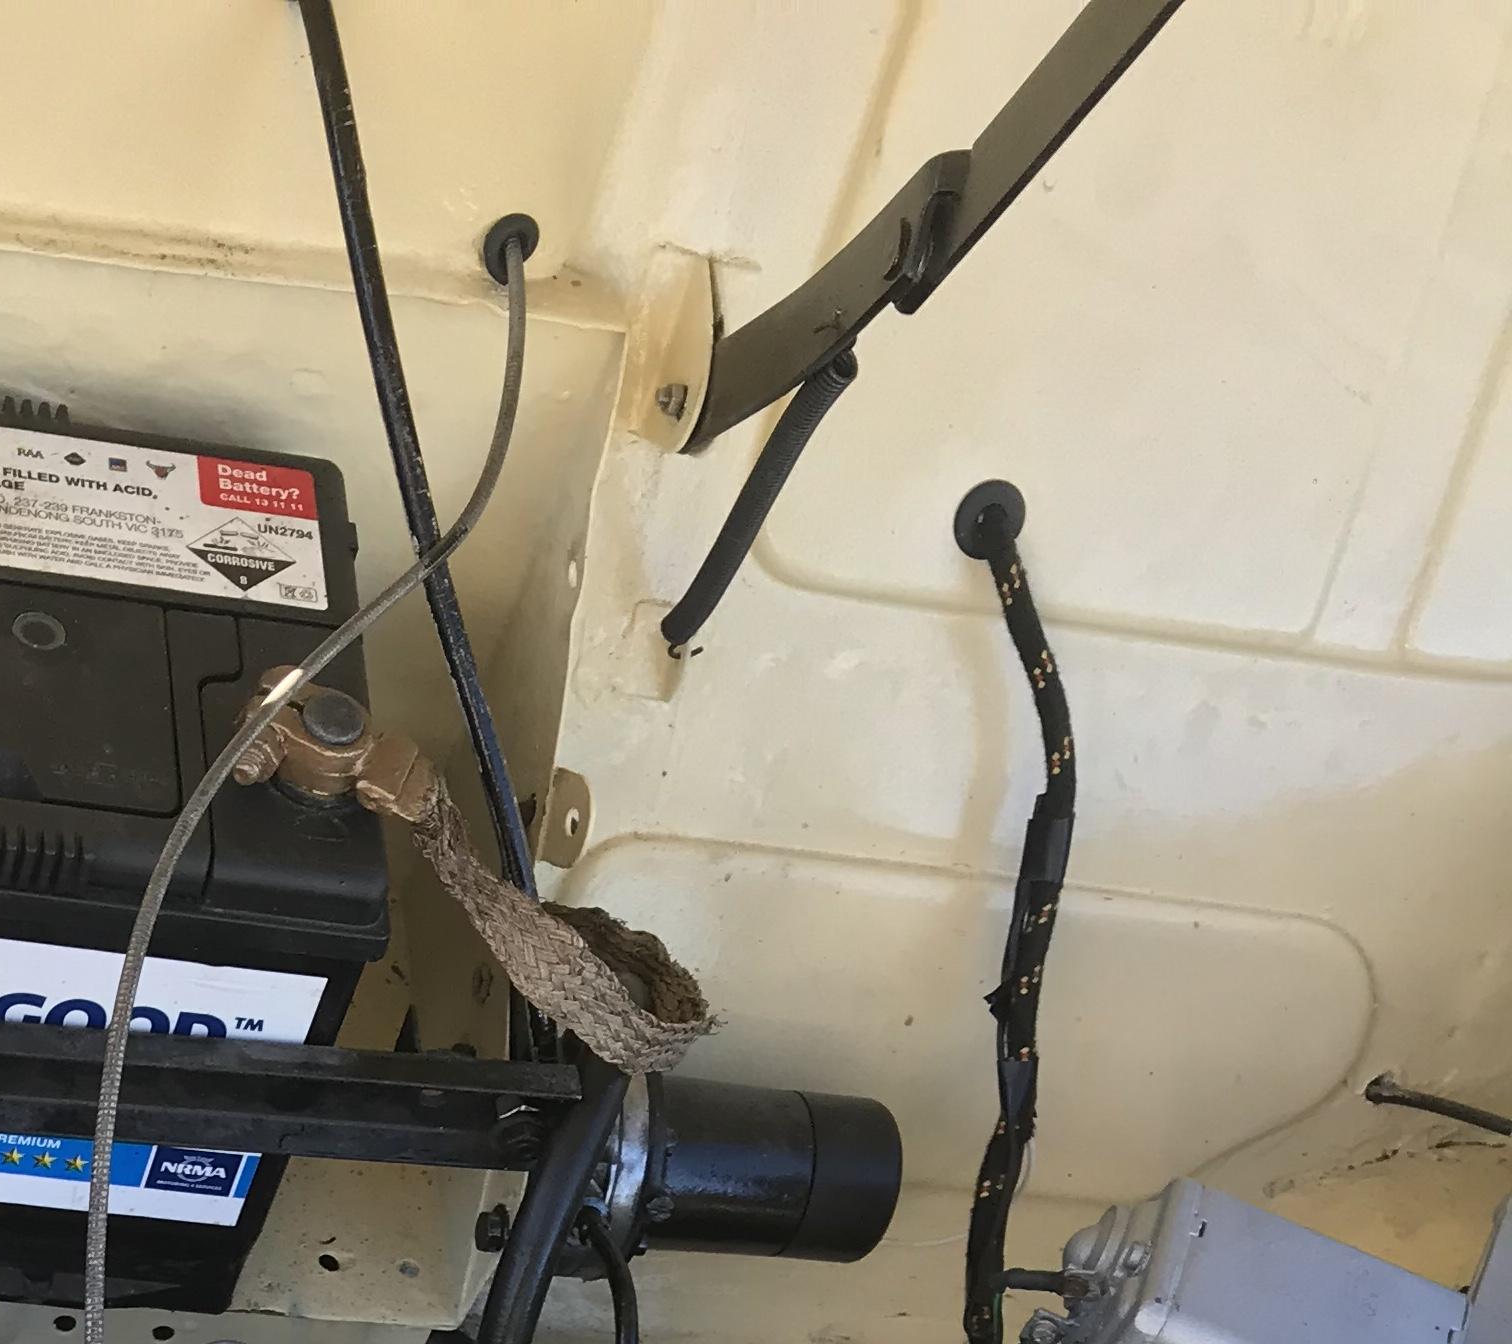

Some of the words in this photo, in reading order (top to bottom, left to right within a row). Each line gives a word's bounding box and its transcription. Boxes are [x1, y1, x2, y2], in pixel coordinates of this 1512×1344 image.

[16, 447, 45, 460] RAA
[3, 467, 60, 483] FILLED
[65, 476, 108, 491] WITH
[217, 463, 268, 482] Dead
[218, 477, 301, 500] Battery?
[219, 492, 252, 504] CALL
[73, 515, 123, 530] SOUTH
[125, 522, 148, 534] VIC
[257, 523, 314, 541] UN2794
[207, 552, 276, 572] CORROSIVE
[159, 1160, 228, 1180] NRMA
